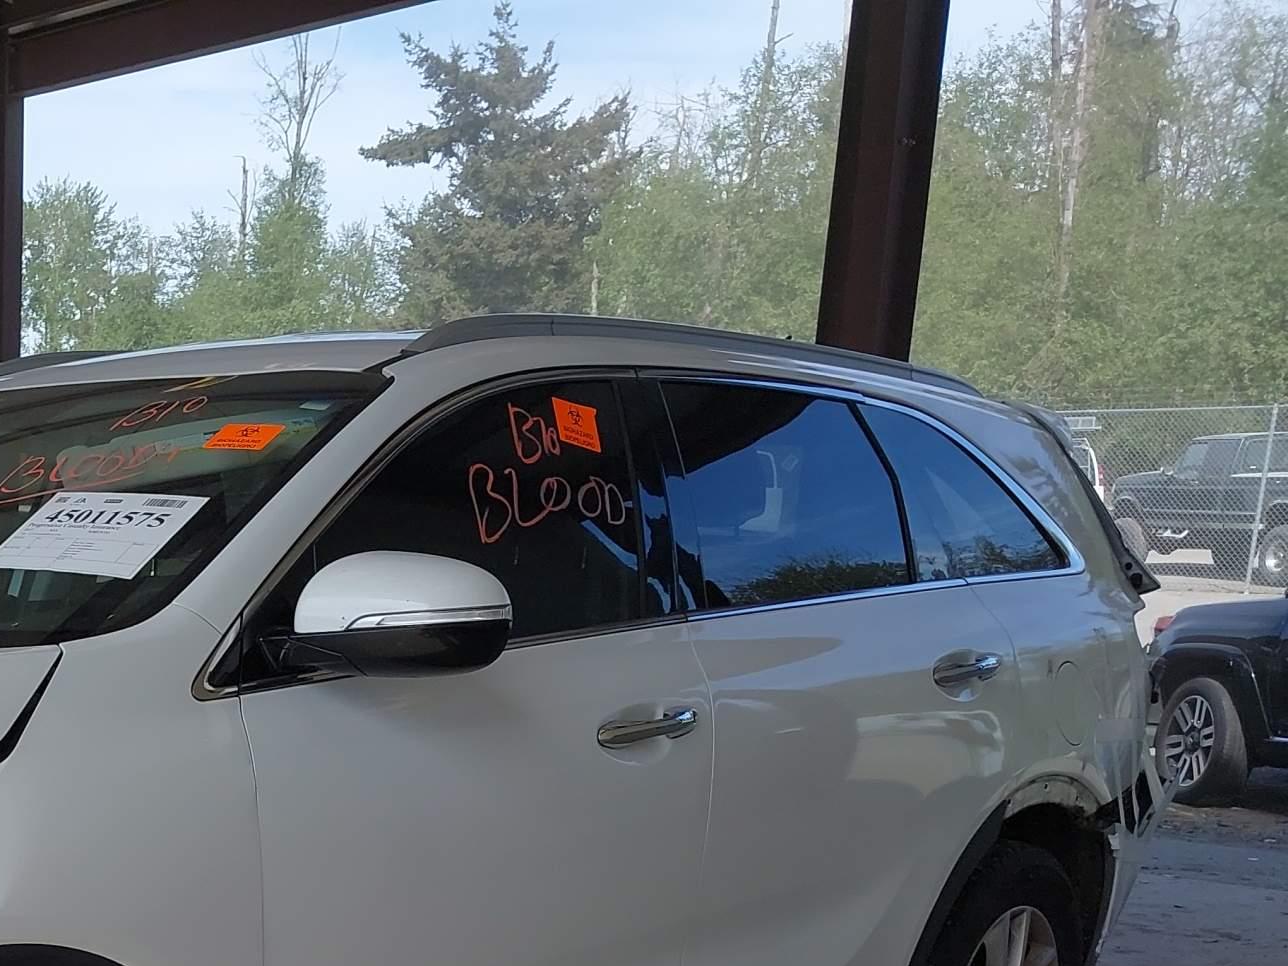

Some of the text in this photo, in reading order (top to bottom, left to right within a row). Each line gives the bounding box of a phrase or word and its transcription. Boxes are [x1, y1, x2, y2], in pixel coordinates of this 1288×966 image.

[110, 396, 208, 431] BIO
[45, 508, 172, 528] 45011575
[468, 463, 626, 544] BLOOD
